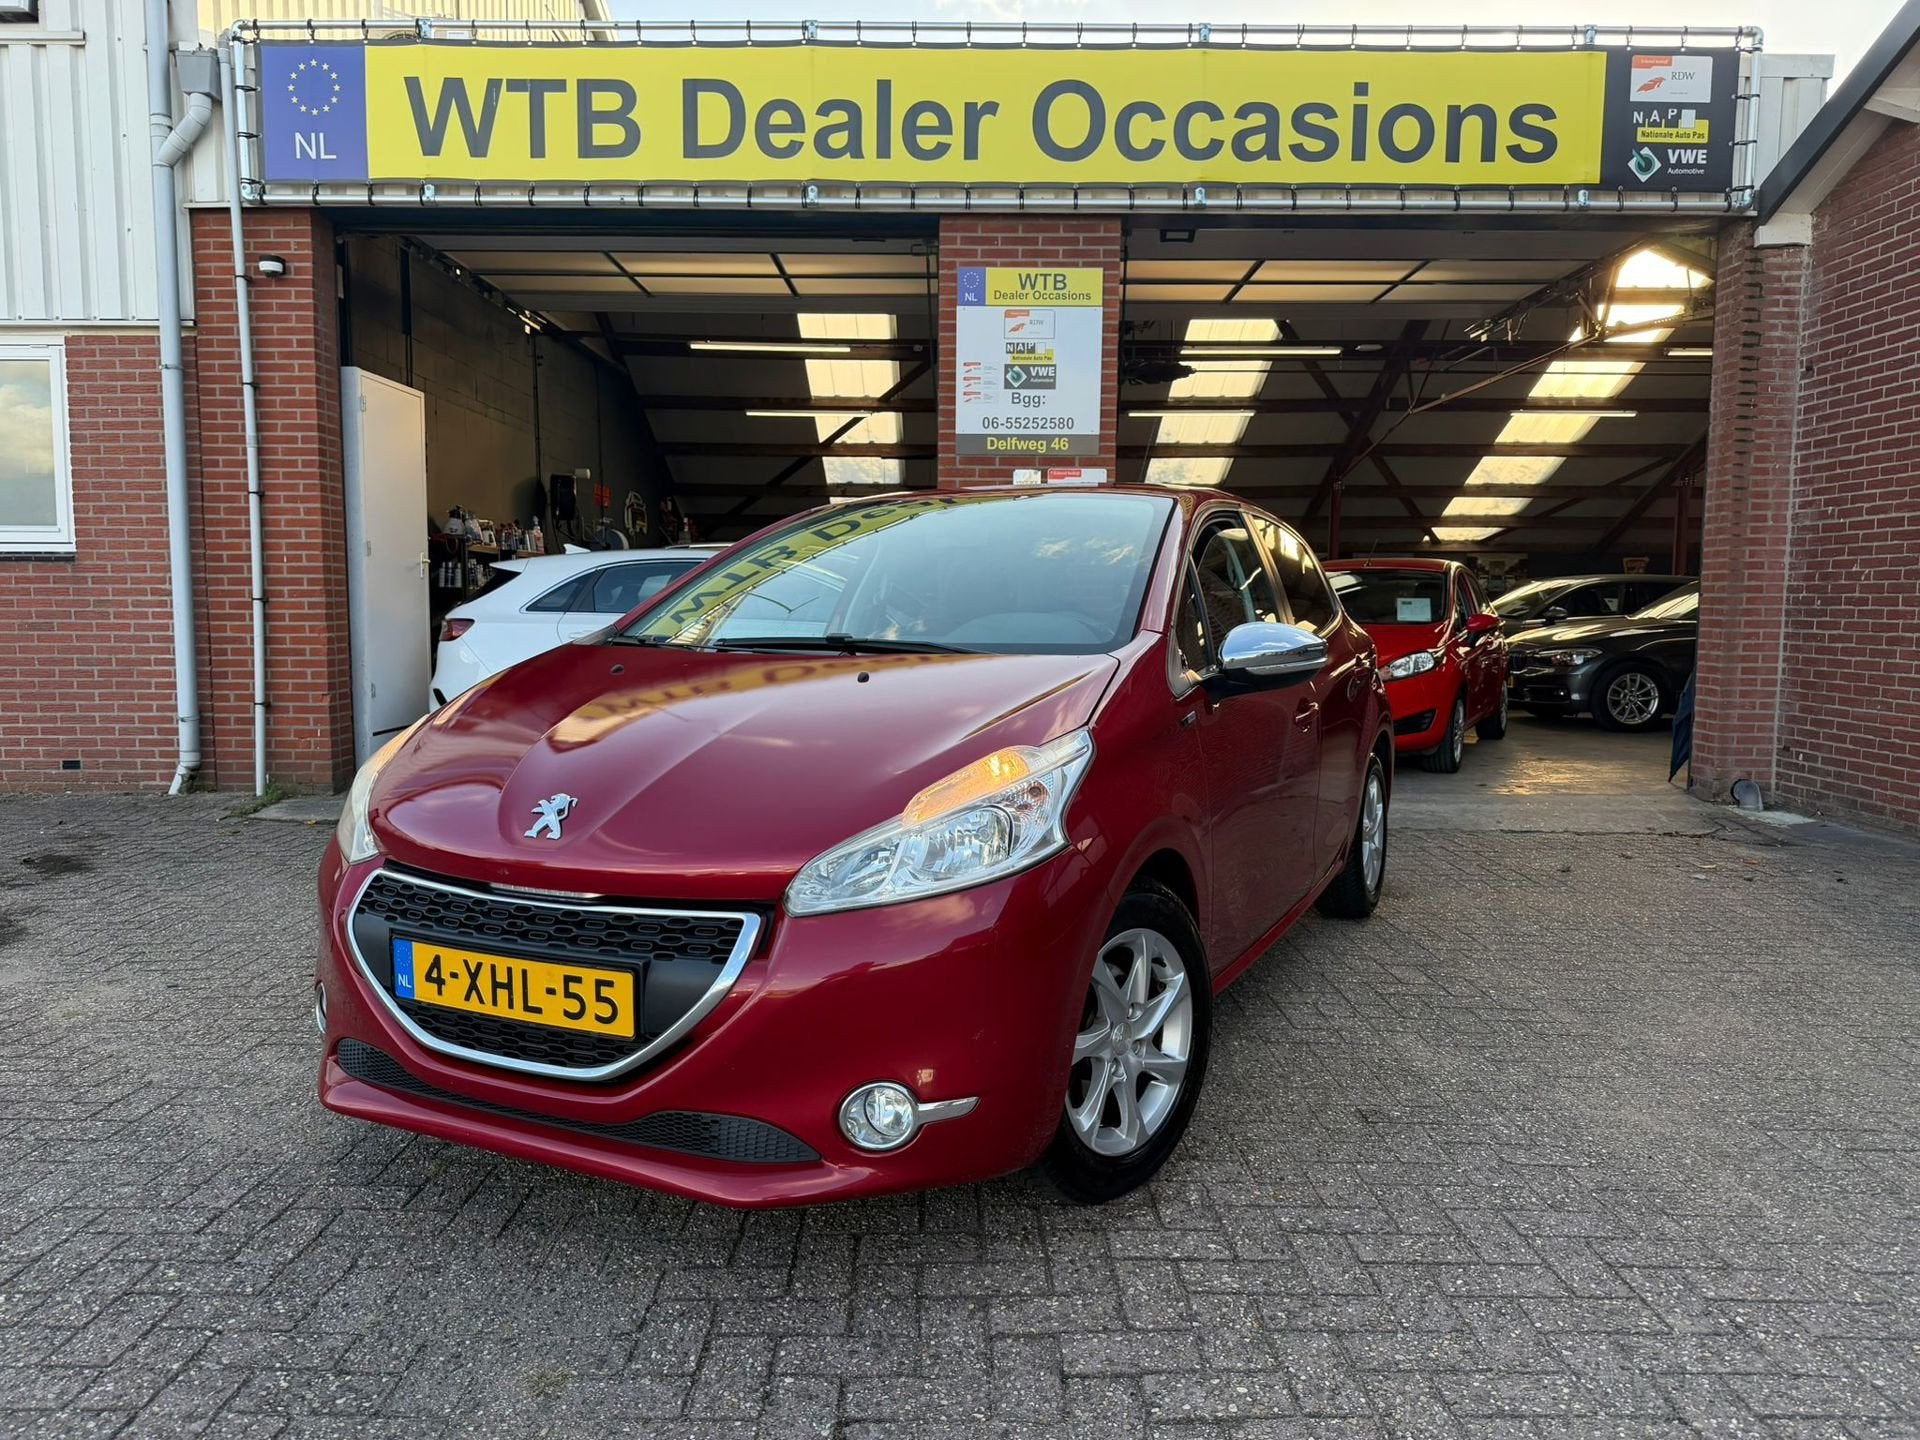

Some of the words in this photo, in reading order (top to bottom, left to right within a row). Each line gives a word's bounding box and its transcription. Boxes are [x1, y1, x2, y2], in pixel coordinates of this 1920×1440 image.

[1671, 71, 1696, 81] RDW
[402, 75, 643, 160] WTB
[682, 78, 1000, 162] Dealer
[1031, 78, 1560, 165] Occasions
[1640, 130, 1674, 139] Nationale
[1675, 131, 1691, 139] Auto
[1692, 130, 1705, 139] Pas
[294, 131, 337, 161] NL
[1667, 149, 1708, 164] VWE
[1667, 167, 1705, 175] Automotive
[1018, 272, 1067, 291] WTB
[964, 292, 978, 302] NL
[993, 290, 1029, 300] Dealer
[1032, 290, 1092, 301] Occasions
[1030, 366, 1056, 377] VWE
[1011, 392, 1046, 408] Bgg:
[982, 416, 1075, 430] 06-55252580
[986, 437, 1047, 453] Delfweg
[1050, 437, 1069, 451] 46
[397, 974, 412, 989] NL
[424, 953, 619, 1025] 4-XHL-55
